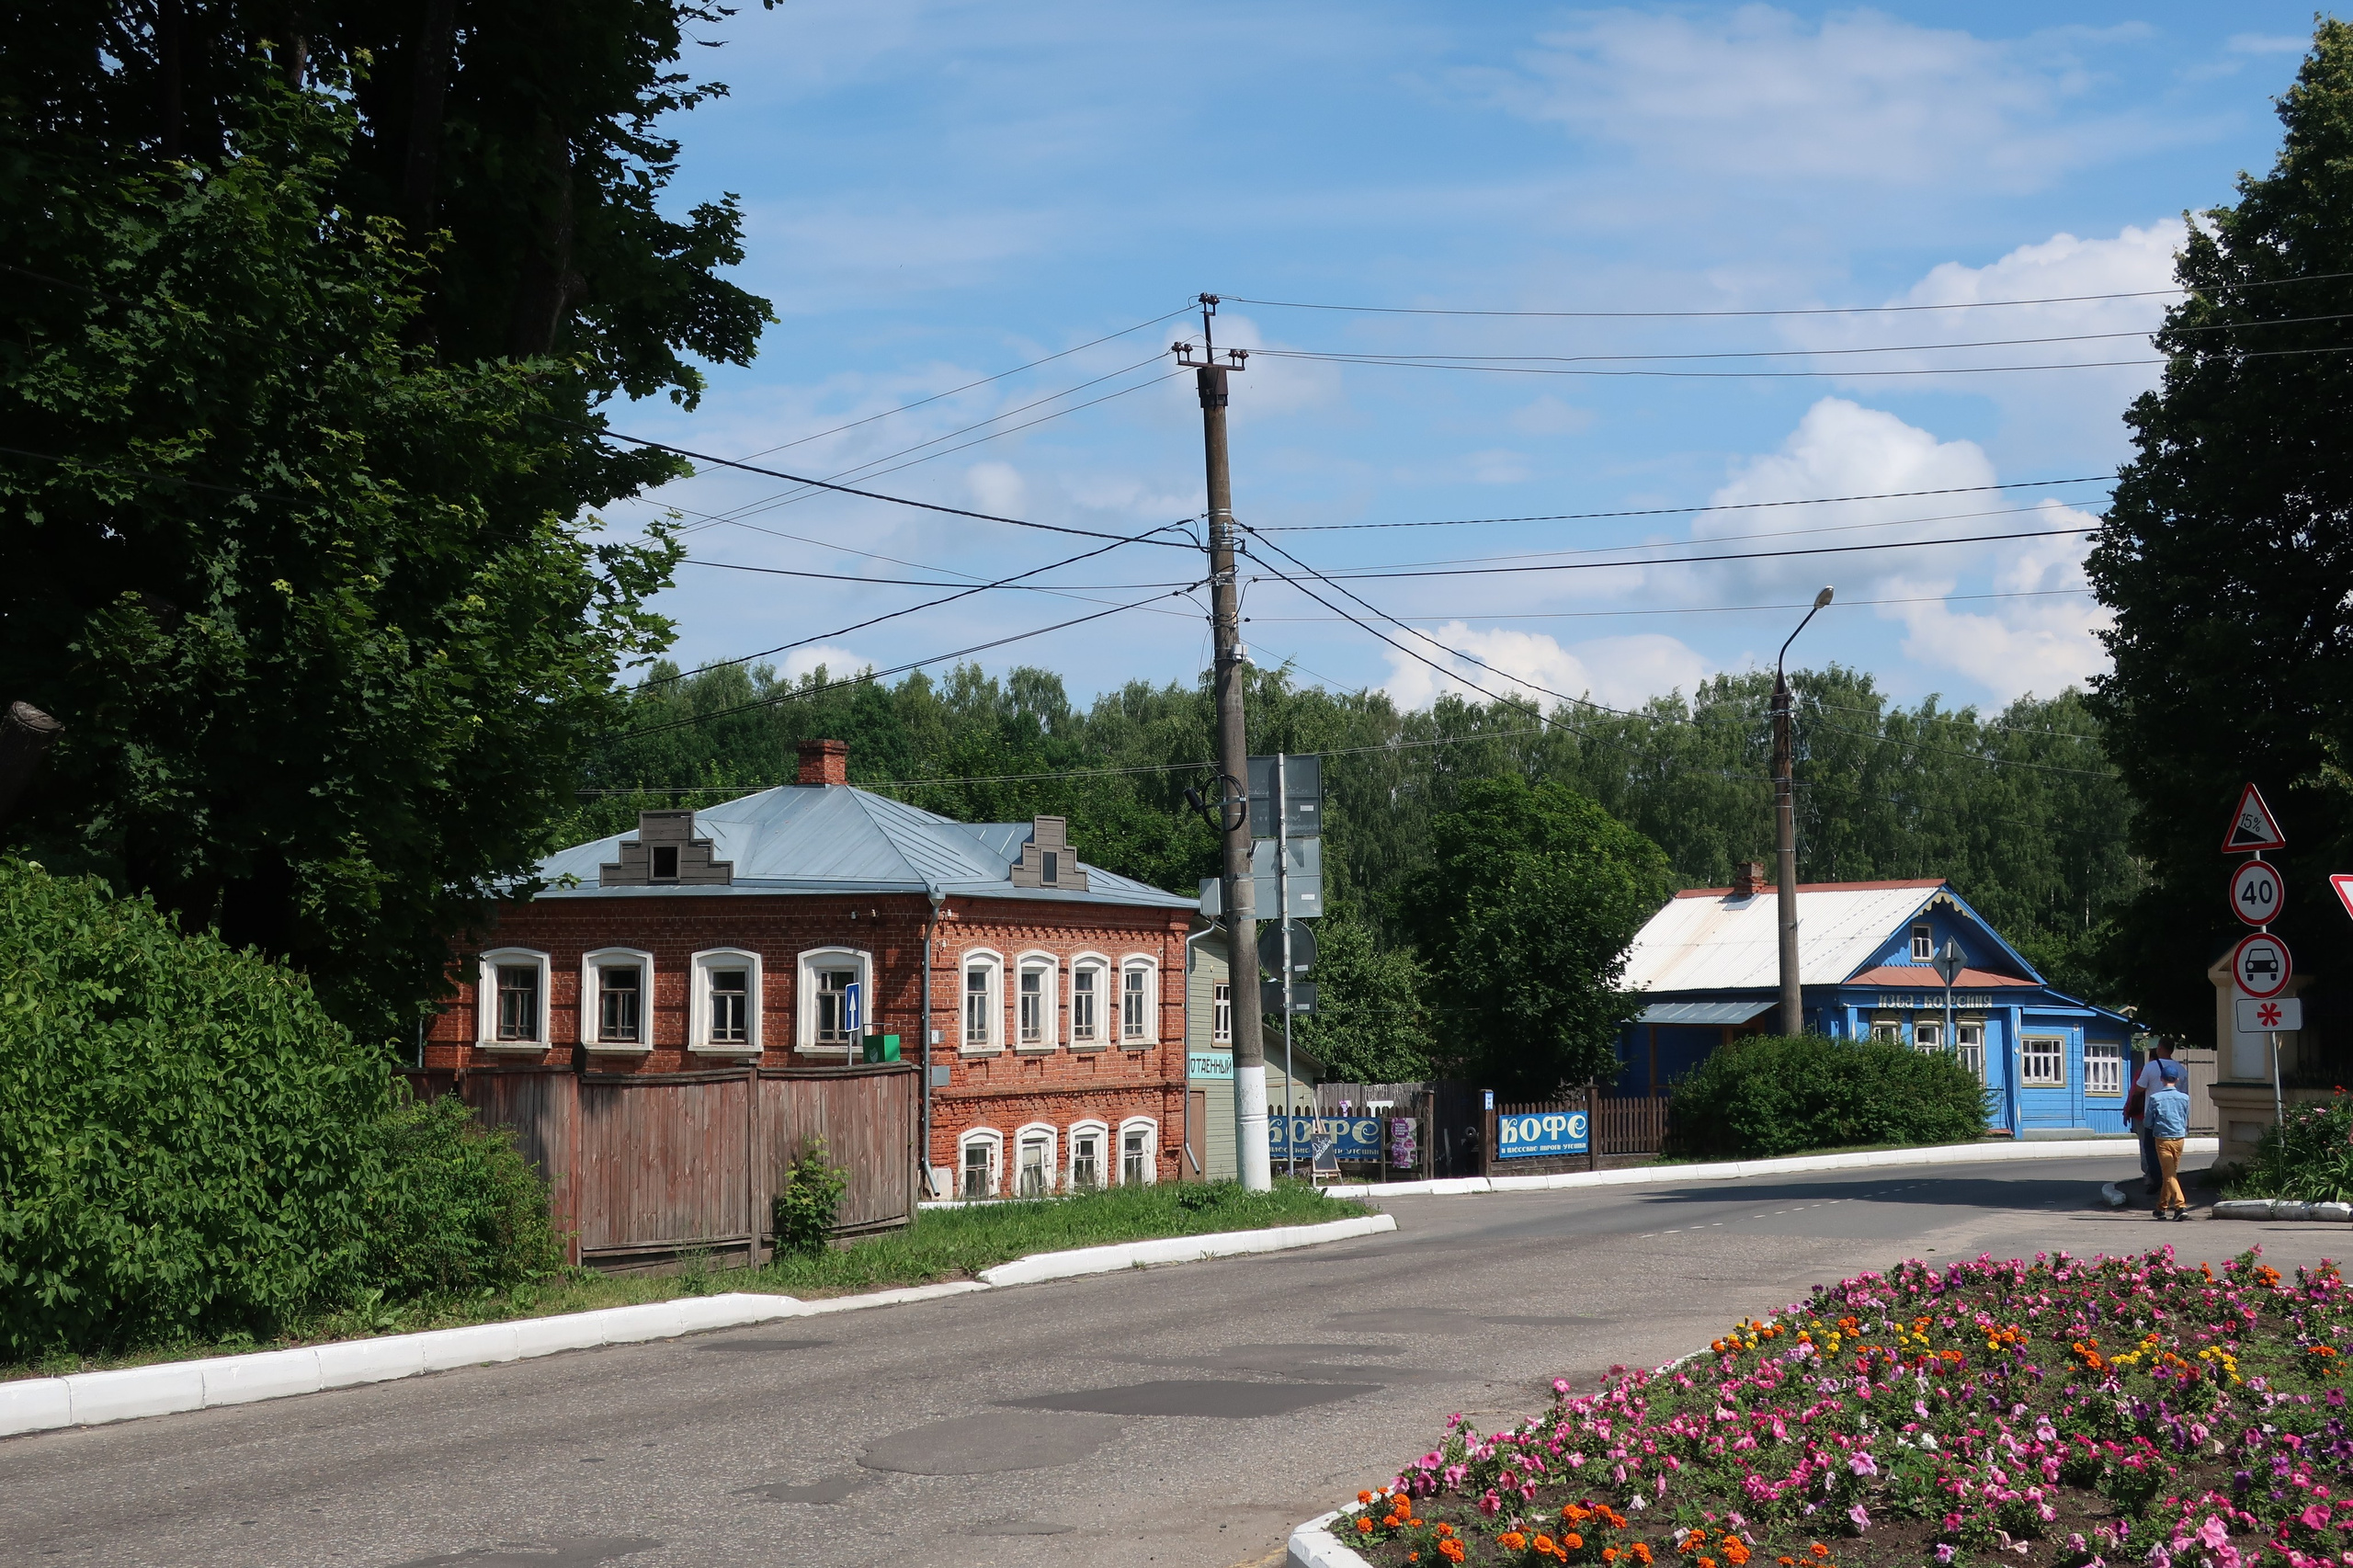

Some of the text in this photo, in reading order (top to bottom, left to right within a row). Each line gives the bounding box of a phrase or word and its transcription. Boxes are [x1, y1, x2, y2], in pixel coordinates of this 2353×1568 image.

[2241, 812, 2261, 832] 15%
[2242, 880, 2273, 905] 40
[1190, 1056, 1232, 1074] ОТАЁННЫЙ
[1501, 1115, 1586, 1143] КОФЕ
